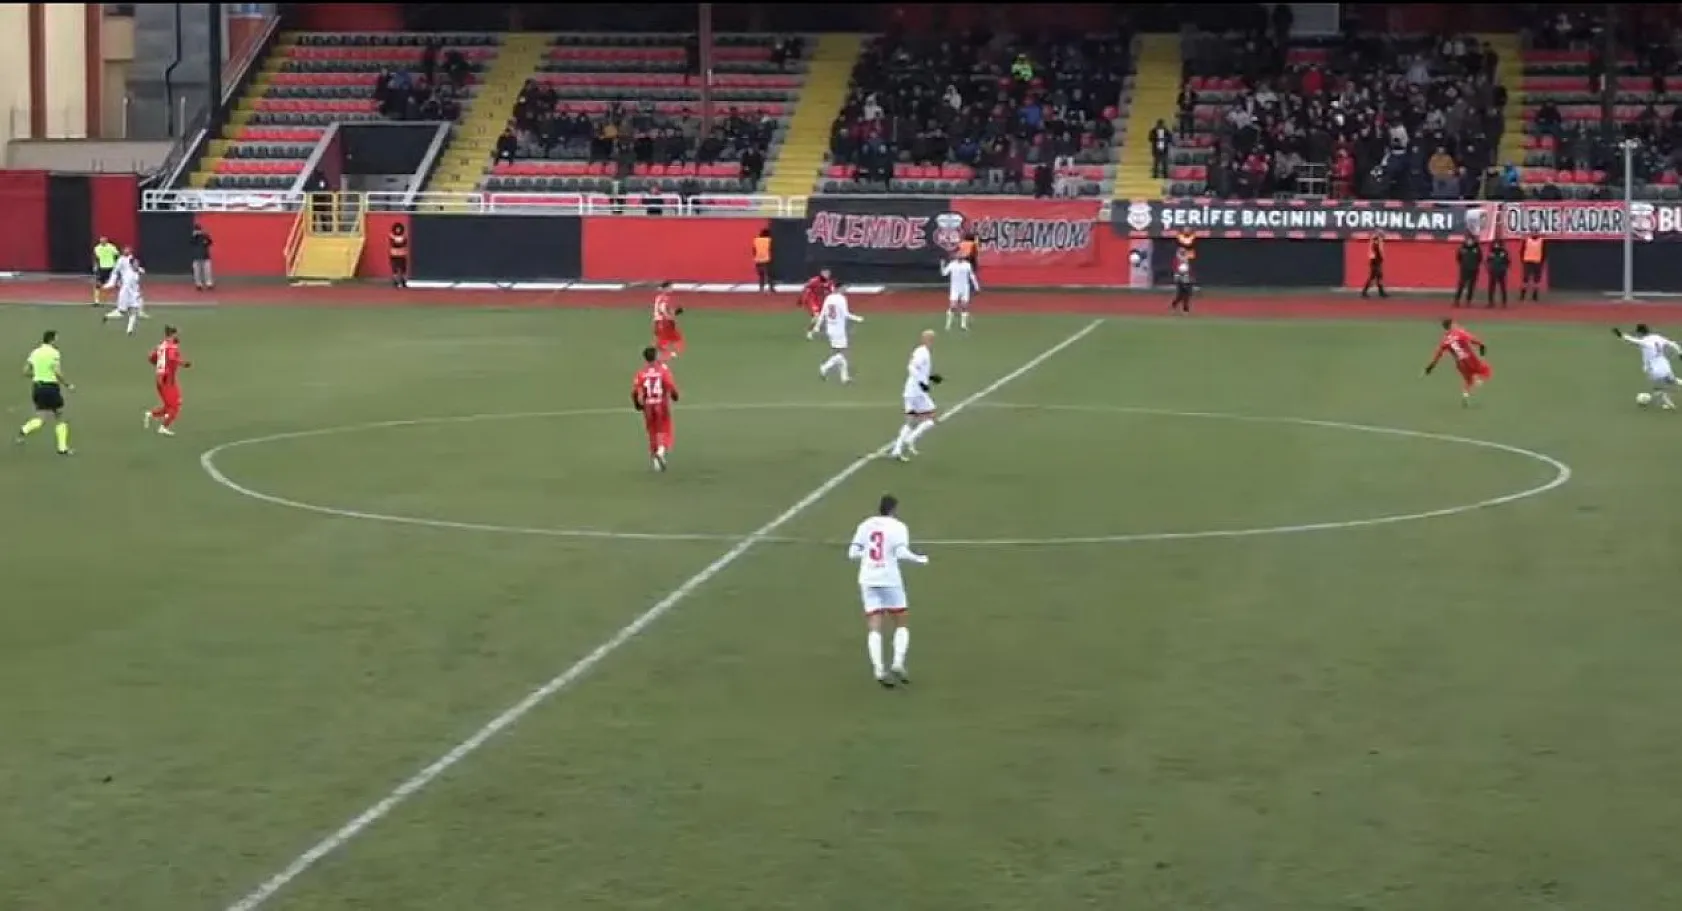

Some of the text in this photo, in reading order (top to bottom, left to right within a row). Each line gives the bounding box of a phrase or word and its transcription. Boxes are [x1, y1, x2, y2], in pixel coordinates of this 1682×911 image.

[1161, 205, 1453, 229] ŞERİFE BACININ TORUNLARI
[1564, 207, 1623, 232] KADAR
[643, 376, 663, 398] 14
[869, 530, 885, 562] 3
